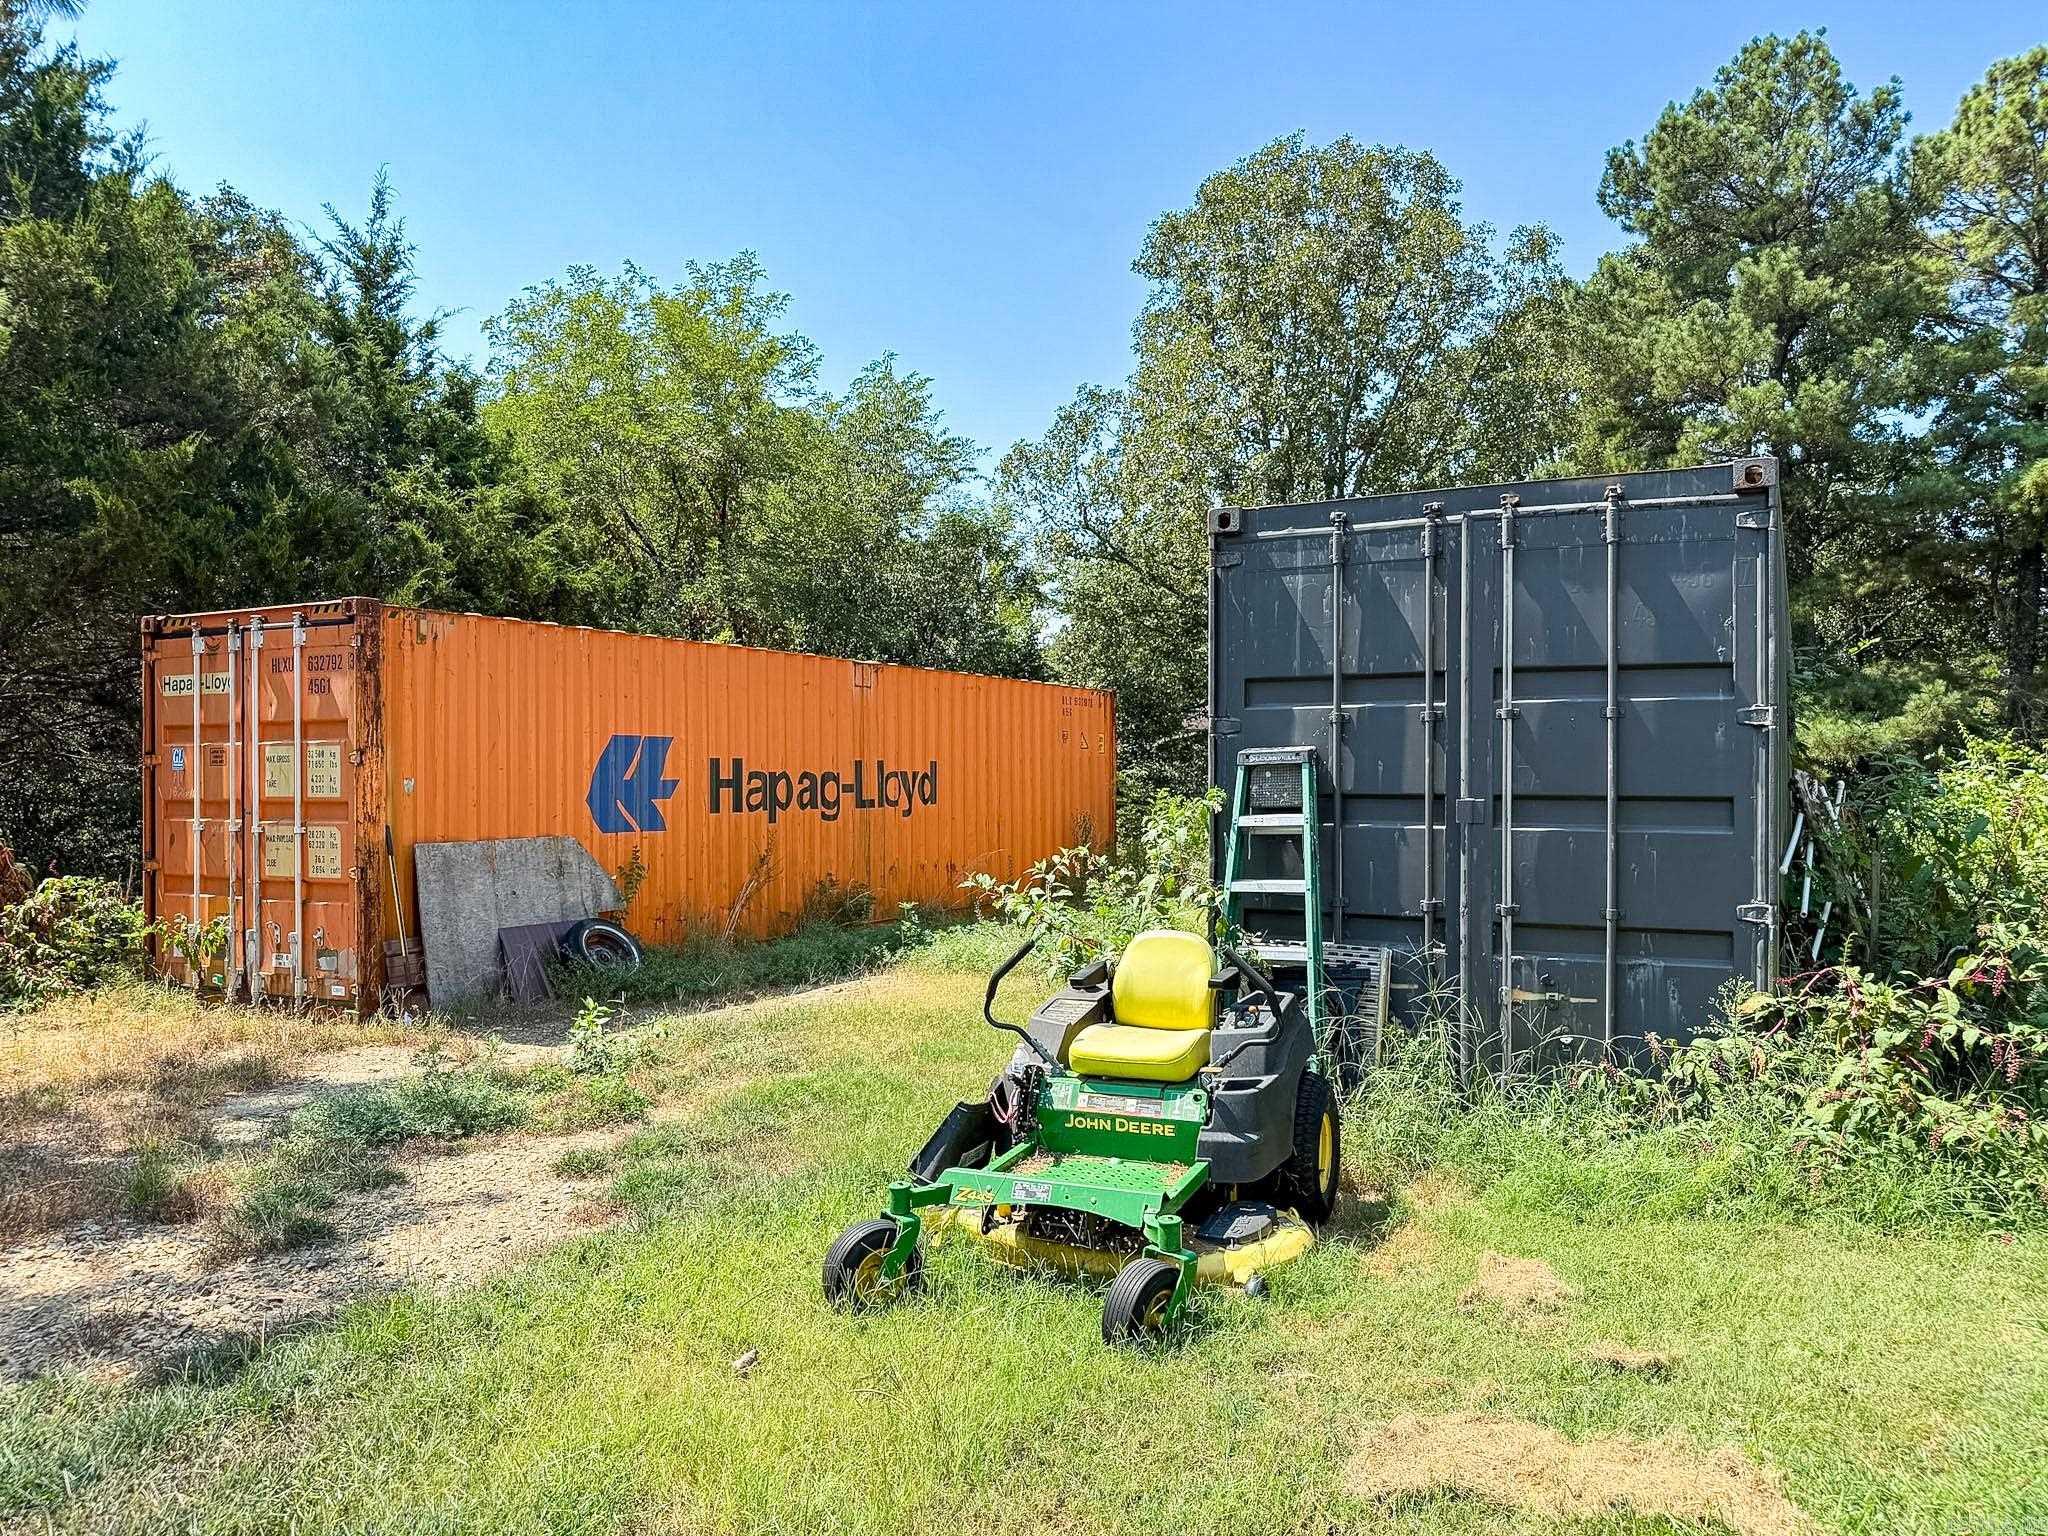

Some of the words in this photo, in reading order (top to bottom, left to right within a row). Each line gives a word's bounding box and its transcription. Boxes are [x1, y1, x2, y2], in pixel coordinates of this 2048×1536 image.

[272, 656, 294, 673] HLXU
[307, 654, 342, 671] 632792
[163, 673, 231, 694] Hapa-Lloy
[308, 678, 330, 694] 45G1
[709, 757, 937, 824] Hapag-Lloyd
[1065, 1114, 1111, 1131] JOHN
[1116, 1118, 1176, 1137] DEERE
